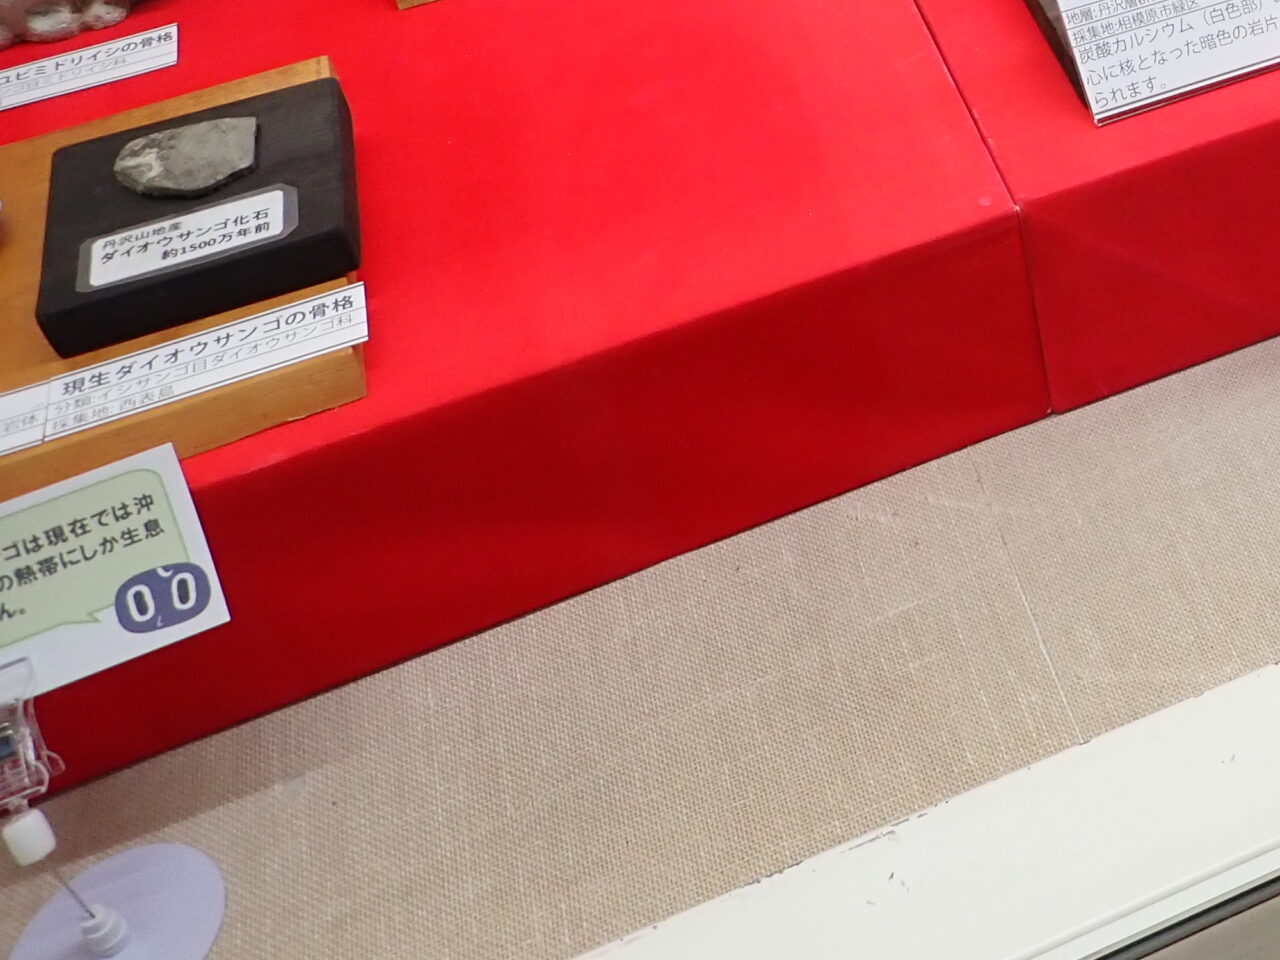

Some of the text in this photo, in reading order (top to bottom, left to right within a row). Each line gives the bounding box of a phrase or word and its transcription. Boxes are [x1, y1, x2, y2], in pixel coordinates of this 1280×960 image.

[0, 31, 174, 86] ユビミドリイシの骨格
[1094, 75, 1167, 108] られます。
[100, 208, 270, 265] ダイオウサンゴ化石
[102, 221, 184, 251] 丹沢山地産
[161, 221, 271, 261] 約1500万年前
[62, 293, 355, 396] 現生ダイオウサンゴの骨格
[0, 518, 165, 592] の熱帯にしか生息
